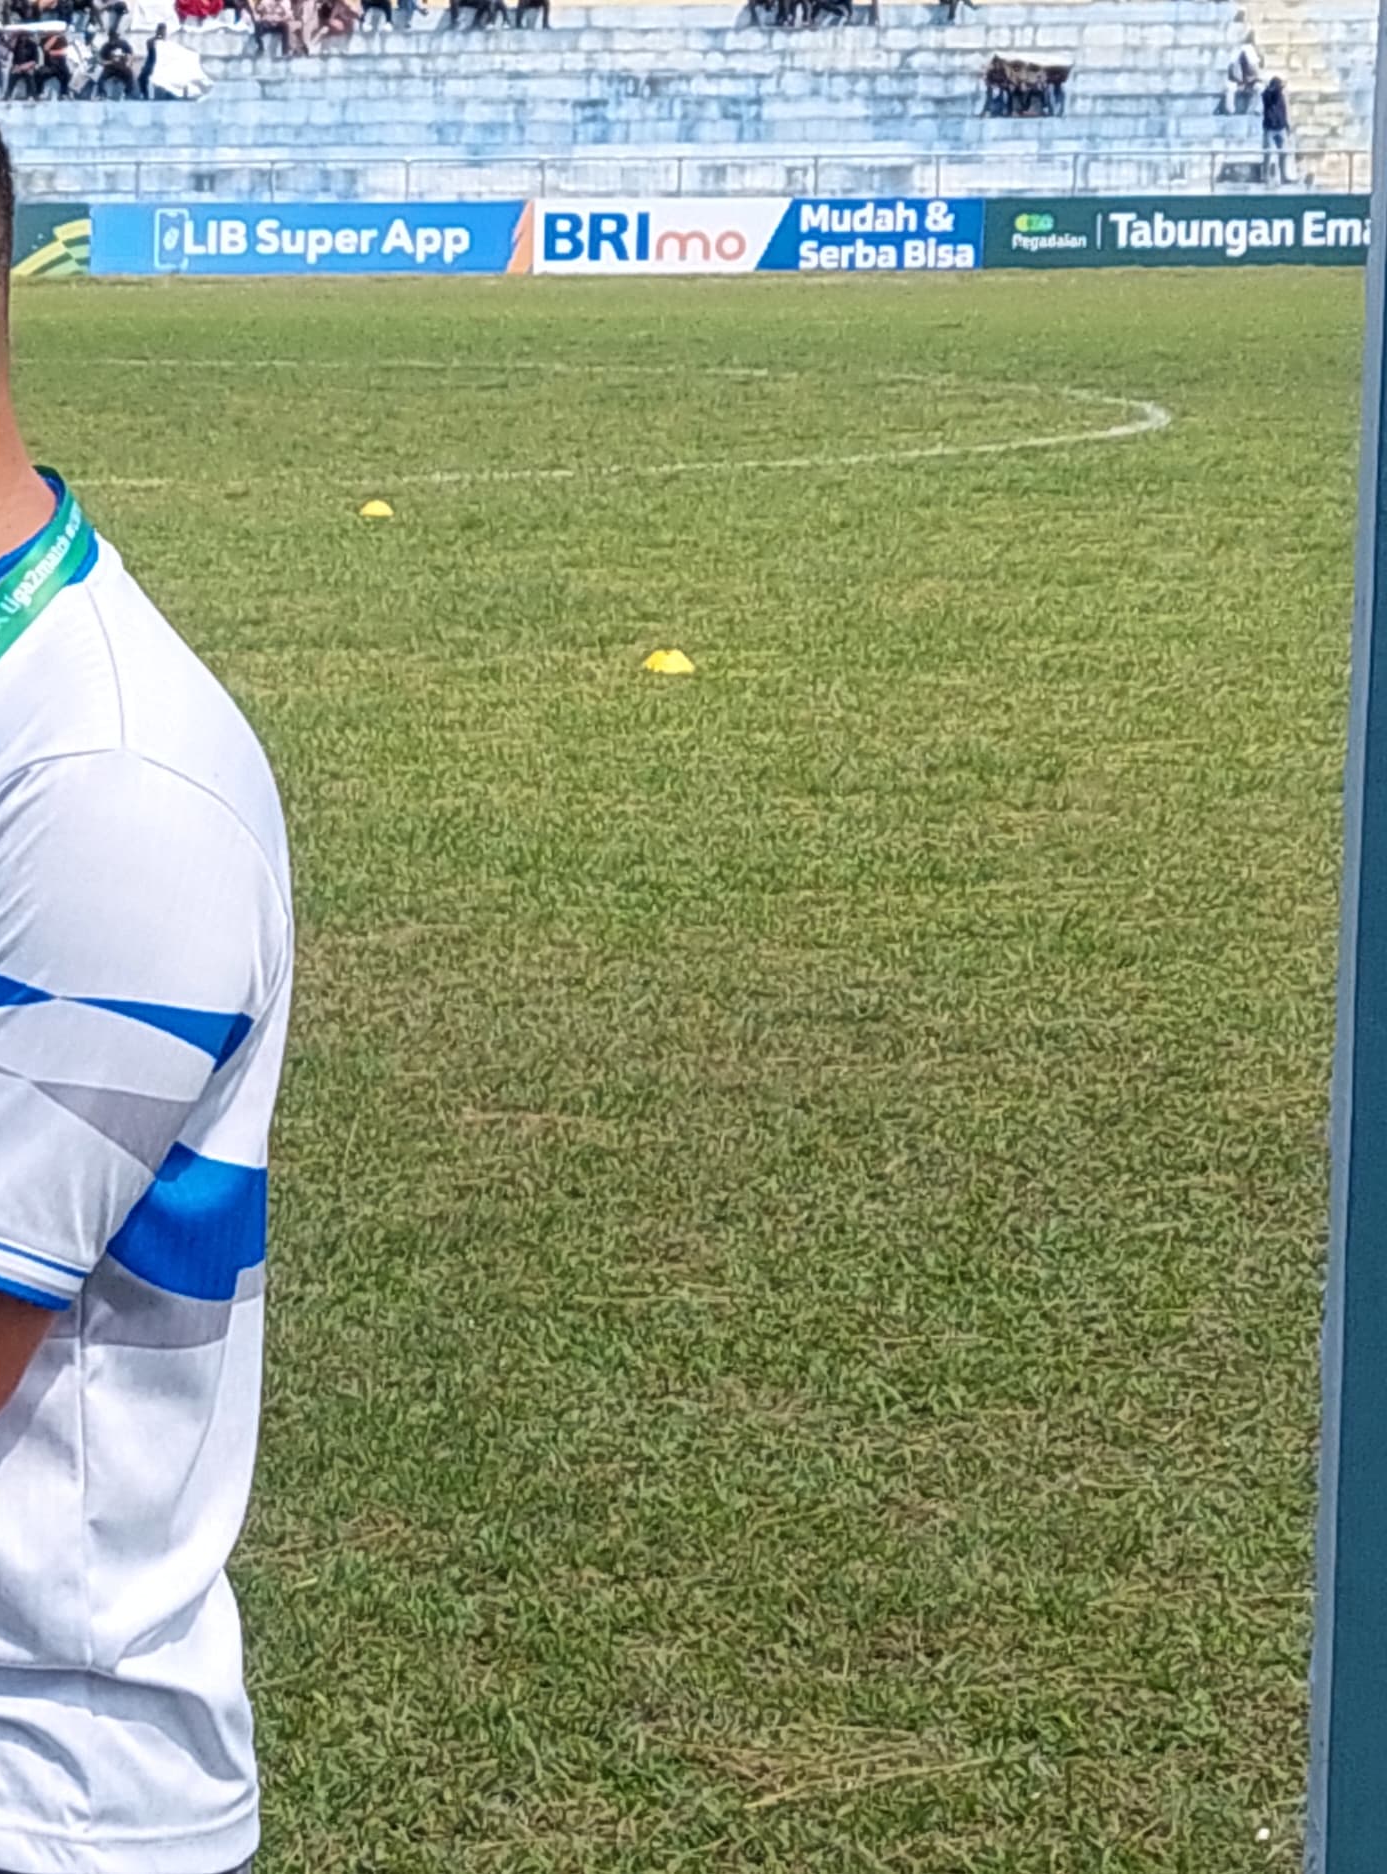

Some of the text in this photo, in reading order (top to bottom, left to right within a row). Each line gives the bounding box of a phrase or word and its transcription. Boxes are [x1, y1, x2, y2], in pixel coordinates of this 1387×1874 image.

[543, 212, 747, 262] BRImo
[799, 202, 955, 233] Mudah &
[1109, 212, 1294, 257] Tabungan
[184, 219, 471, 264] LIB Super App
[799, 239, 975, 269] Serba Bisa
